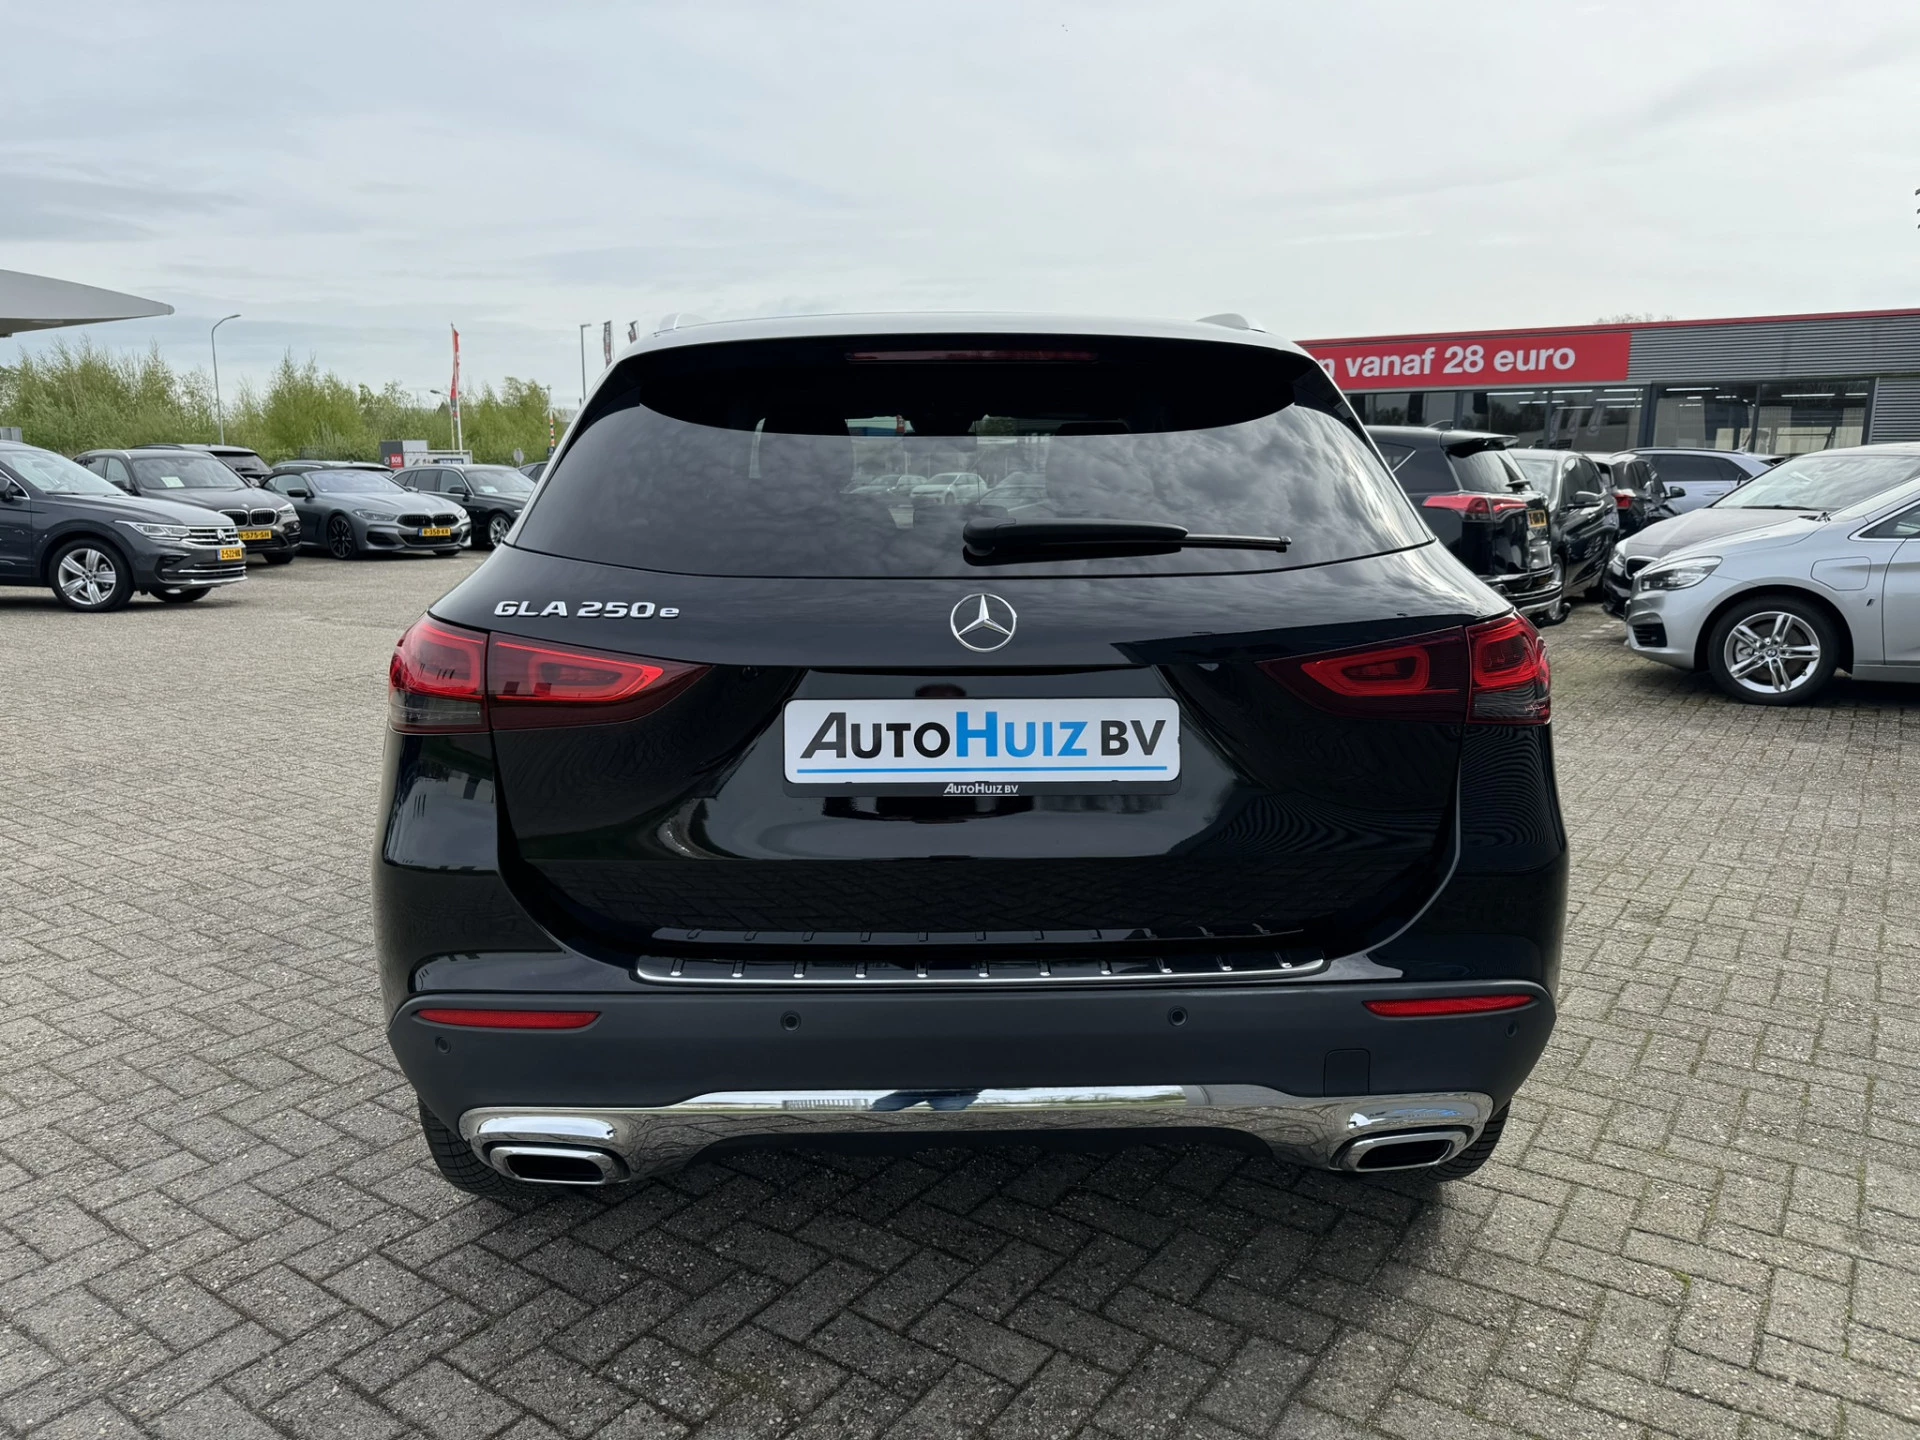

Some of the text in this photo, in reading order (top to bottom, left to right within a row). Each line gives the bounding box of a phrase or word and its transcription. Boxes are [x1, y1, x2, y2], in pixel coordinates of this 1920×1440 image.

[1345, 347, 1436, 378] vanaf
[1443, 345, 1484, 374] 28
[1493, 347, 1576, 372] euro
[494, 601, 568, 617] GLA
[1101, 720, 1166, 756] BV
[1005, 785, 1018, 794] BV
